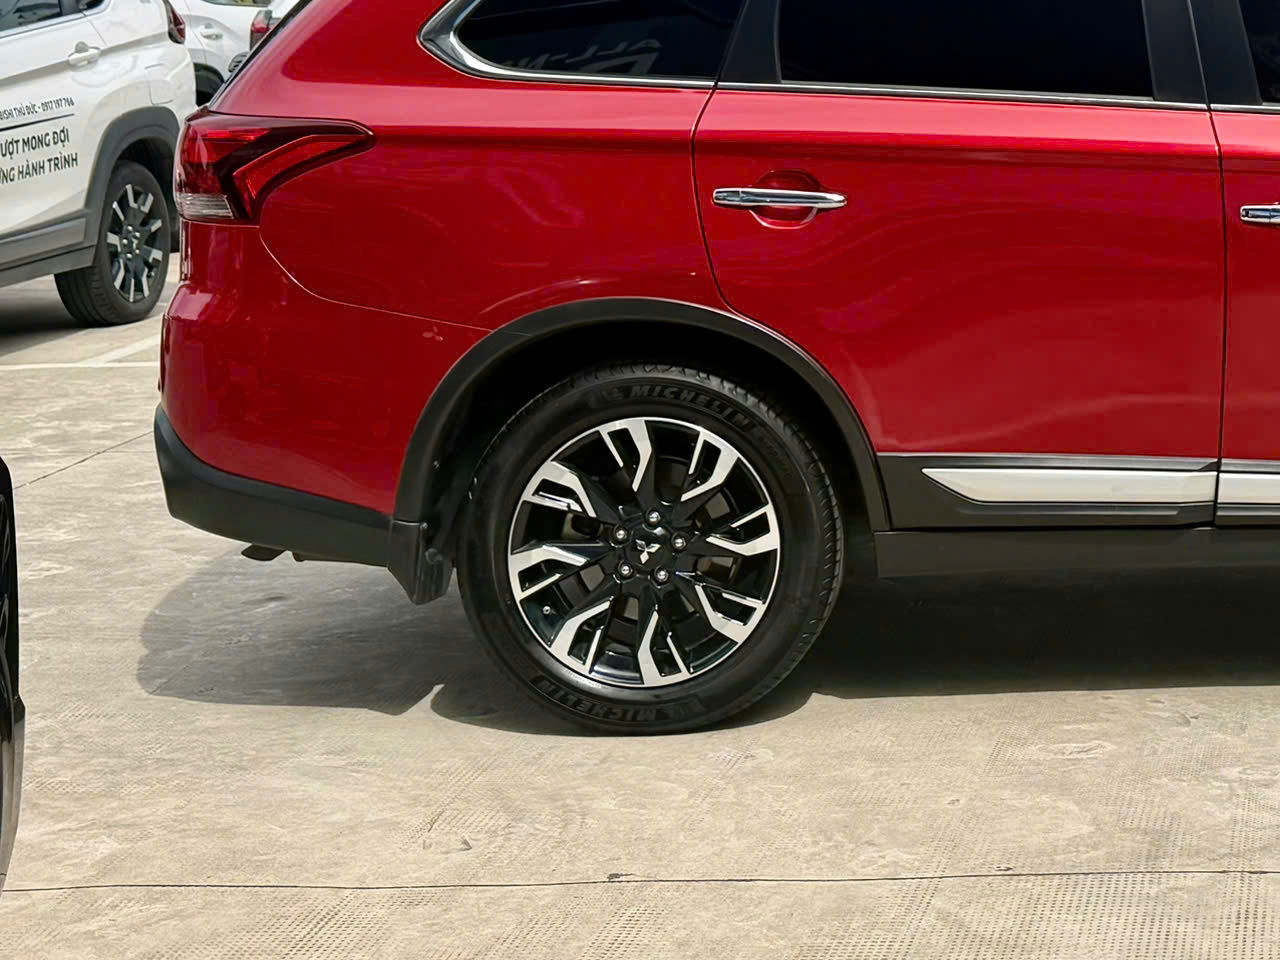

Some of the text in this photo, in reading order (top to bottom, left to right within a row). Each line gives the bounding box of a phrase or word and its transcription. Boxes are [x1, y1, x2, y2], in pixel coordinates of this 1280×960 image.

[22, 132, 51, 153] MONG
[52, 126, 70, 148] ĐỢI
[17, 159, 45, 180] HÀNH
[47, 151, 79, 173] TRÌNH
[628, 385, 754, 433] MICHELIN
